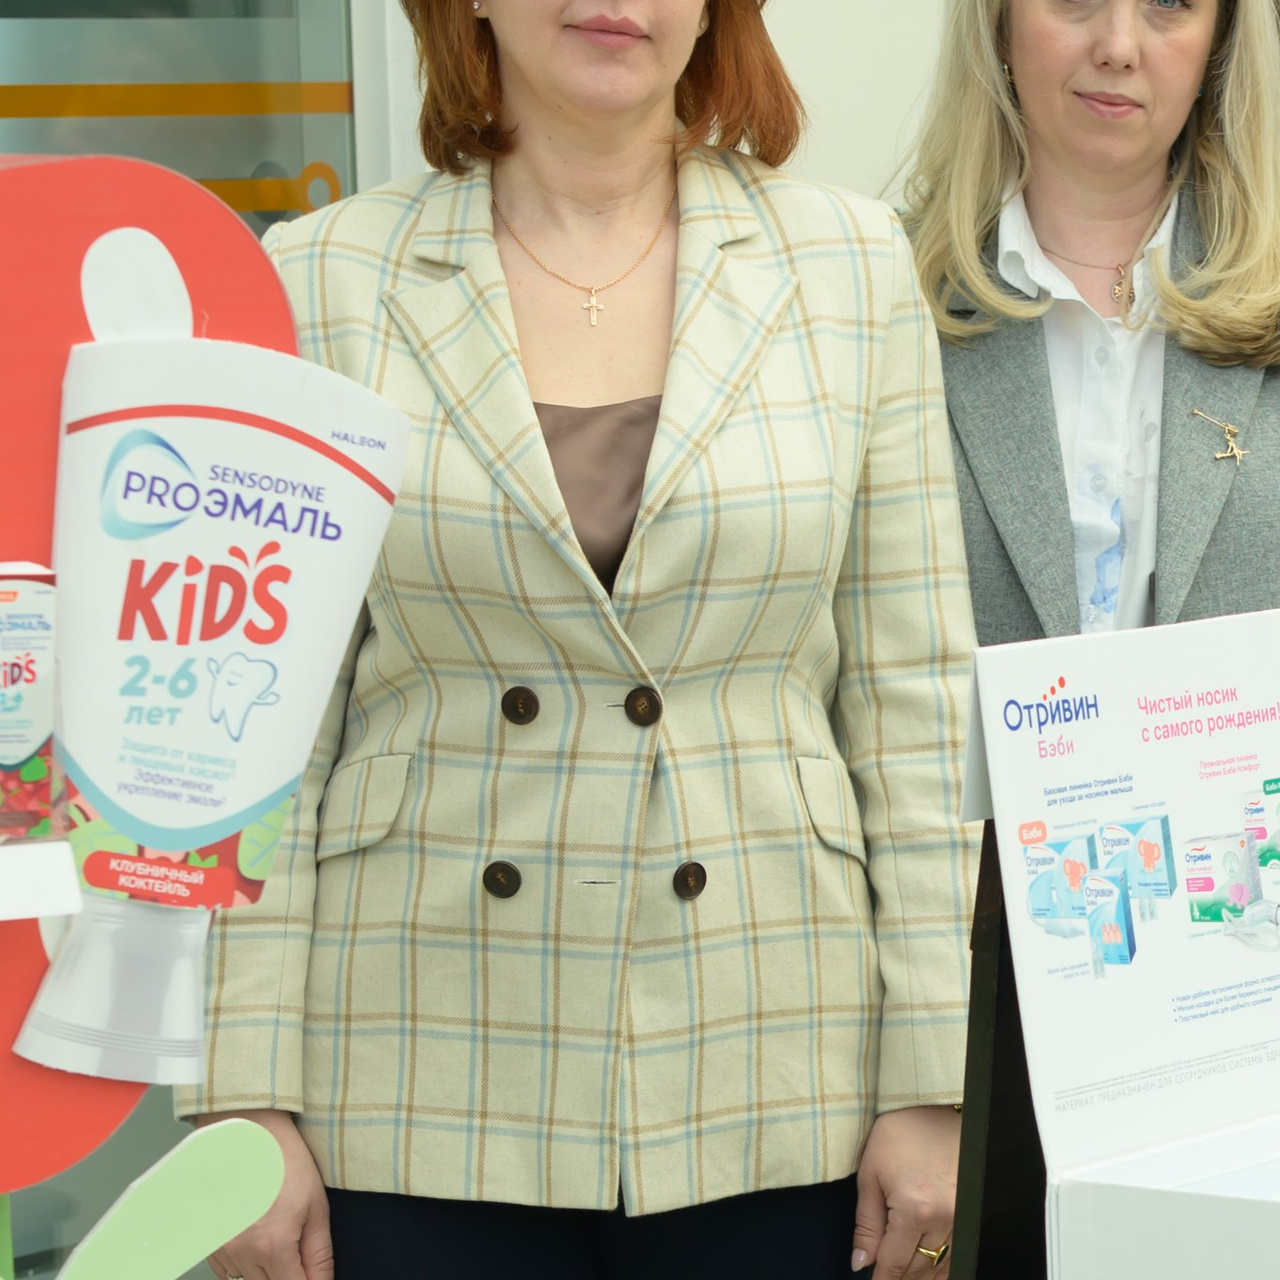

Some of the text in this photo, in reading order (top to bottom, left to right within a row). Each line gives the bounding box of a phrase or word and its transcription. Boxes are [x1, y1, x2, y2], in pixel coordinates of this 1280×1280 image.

[331, 430, 387, 451] HALEON
[208, 463, 327, 504] SENSODYNE
[118, 654, 199, 700] 2-6
[1003, 693, 1100, 735] Отривин
[1137, 686, 1239, 716] Чистый носик
[123, 704, 183, 727] лет
[1141, 727, 1150, 743] с
[1153, 717, 1204, 740] самого
[1037, 734, 1075, 760] Бэби
[1043, 772, 1134, 797] Базовая линейка Отривин Бэби
[1046, 783, 1134, 807] для ухода за носиком малыша
[1022, 825, 1043, 840] Бэби
[108, 856, 205, 886] КЛУБНИЧНЫЙ
[1185, 853, 1212, 865] Отривин
[117, 873, 191, 898] КОКТЕЙЛЬ
[1054, 1094, 1095, 1113] МАТЕРИАЛ
[1096, 1081, 1156, 1104] ПРЕДНАЗНАЧЕН
[1157, 1075, 1173, 1089] ДЛЯ
[1174, 1061, 1228, 1085] СОТРУДНИКОВ
[1228, 1055, 1264, 1072] СИСТЕМЫ
